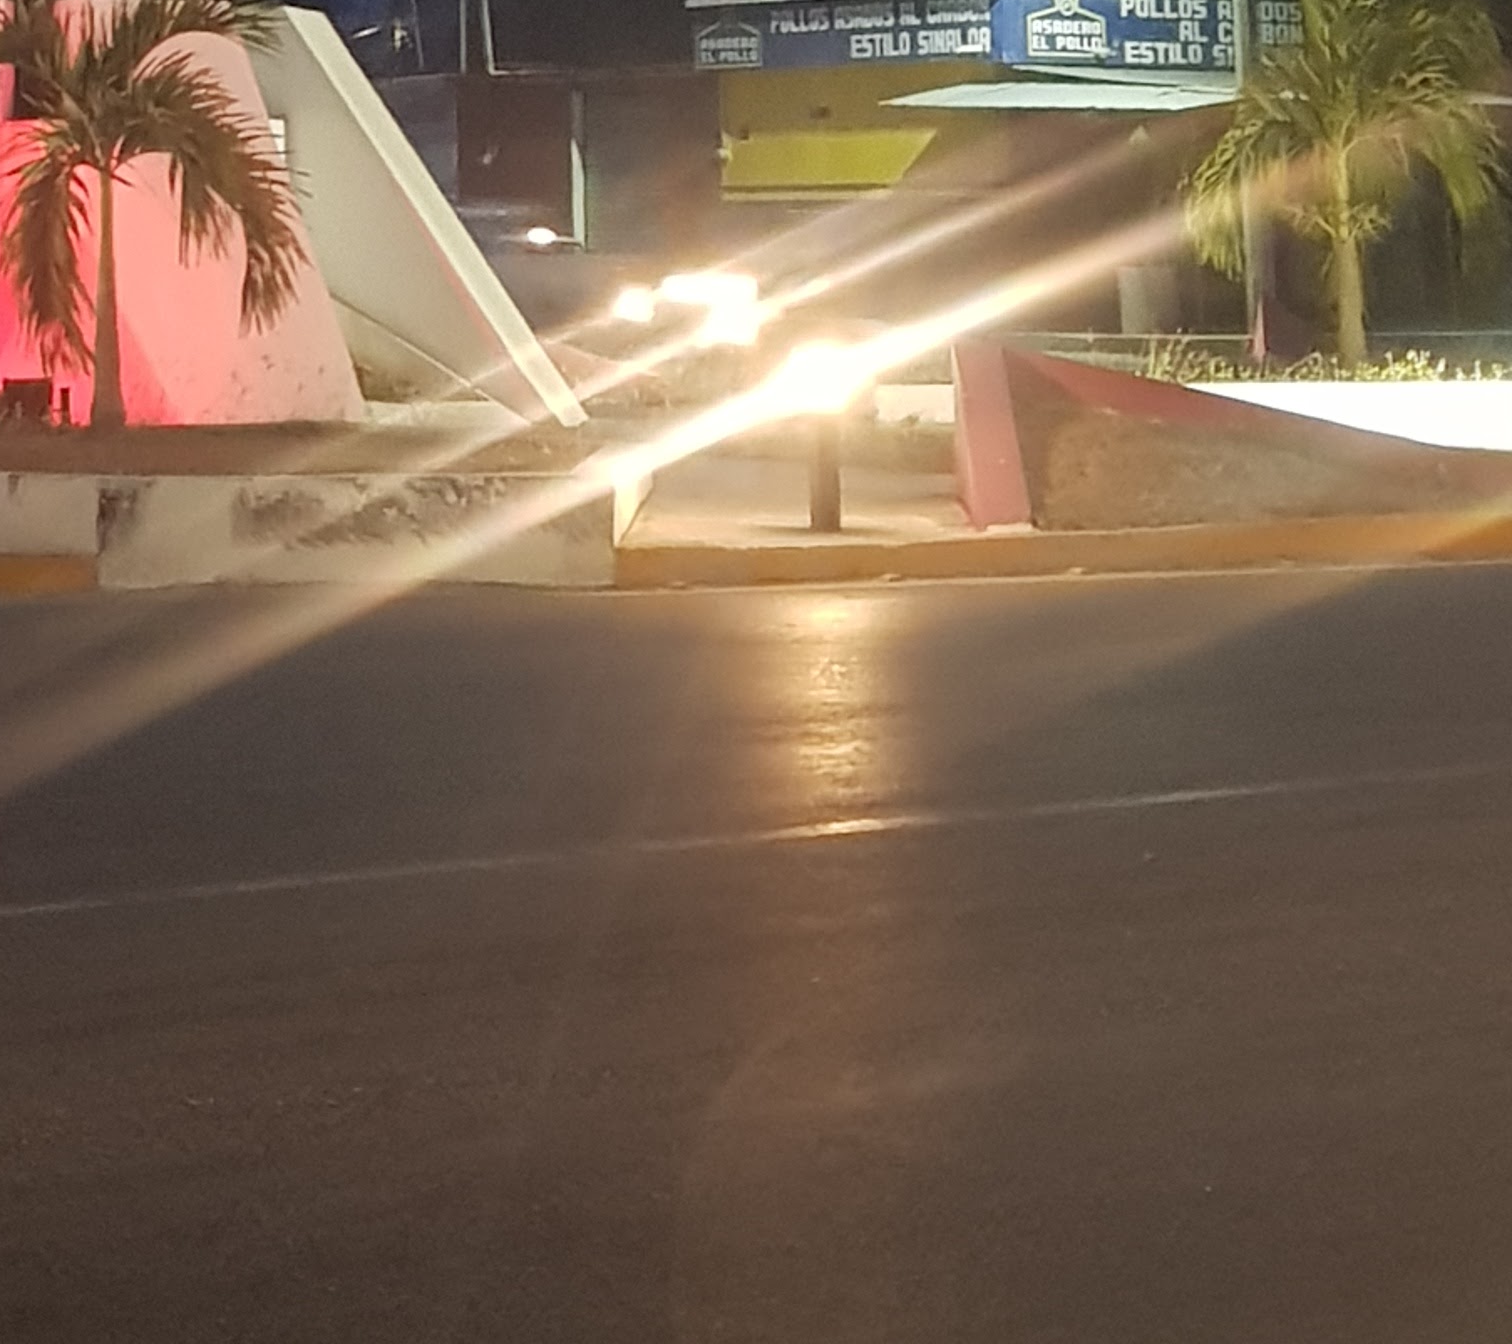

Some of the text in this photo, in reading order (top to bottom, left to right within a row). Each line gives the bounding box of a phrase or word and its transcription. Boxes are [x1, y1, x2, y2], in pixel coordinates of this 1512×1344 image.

[1216, 0, 1303, 22] ADOS
[1032, 19, 1102, 34] ASADERO
[1178, 20, 1304, 44] AL CBON
[850, 26, 991, 58] ESTILO SINALOA
[1032, 35, 1103, 50] EL POLLO
[1124, 41, 1203, 64] ESTILO
